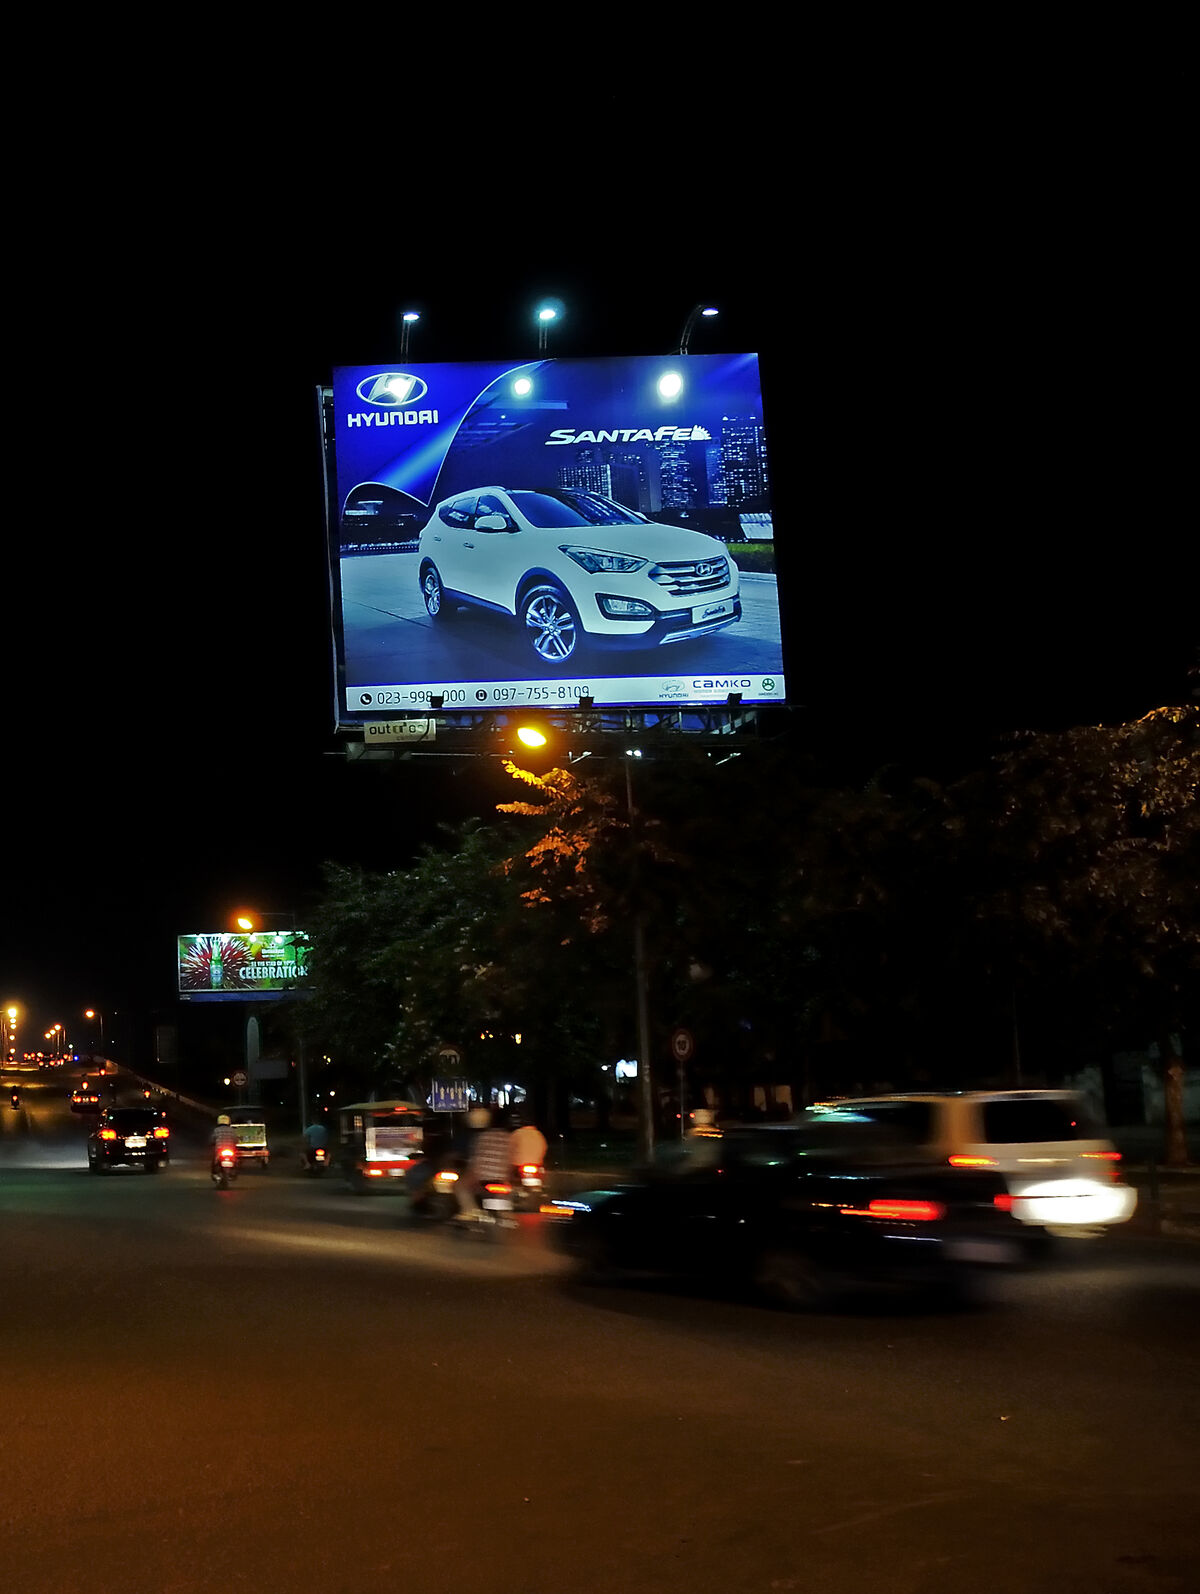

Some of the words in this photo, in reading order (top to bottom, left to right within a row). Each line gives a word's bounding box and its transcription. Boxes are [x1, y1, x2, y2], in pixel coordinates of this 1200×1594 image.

[347, 410, 439, 428] HYUNDAI
[377, 689, 466, 704] 023-998000
[493, 685, 590, 701] 097-755-8109
